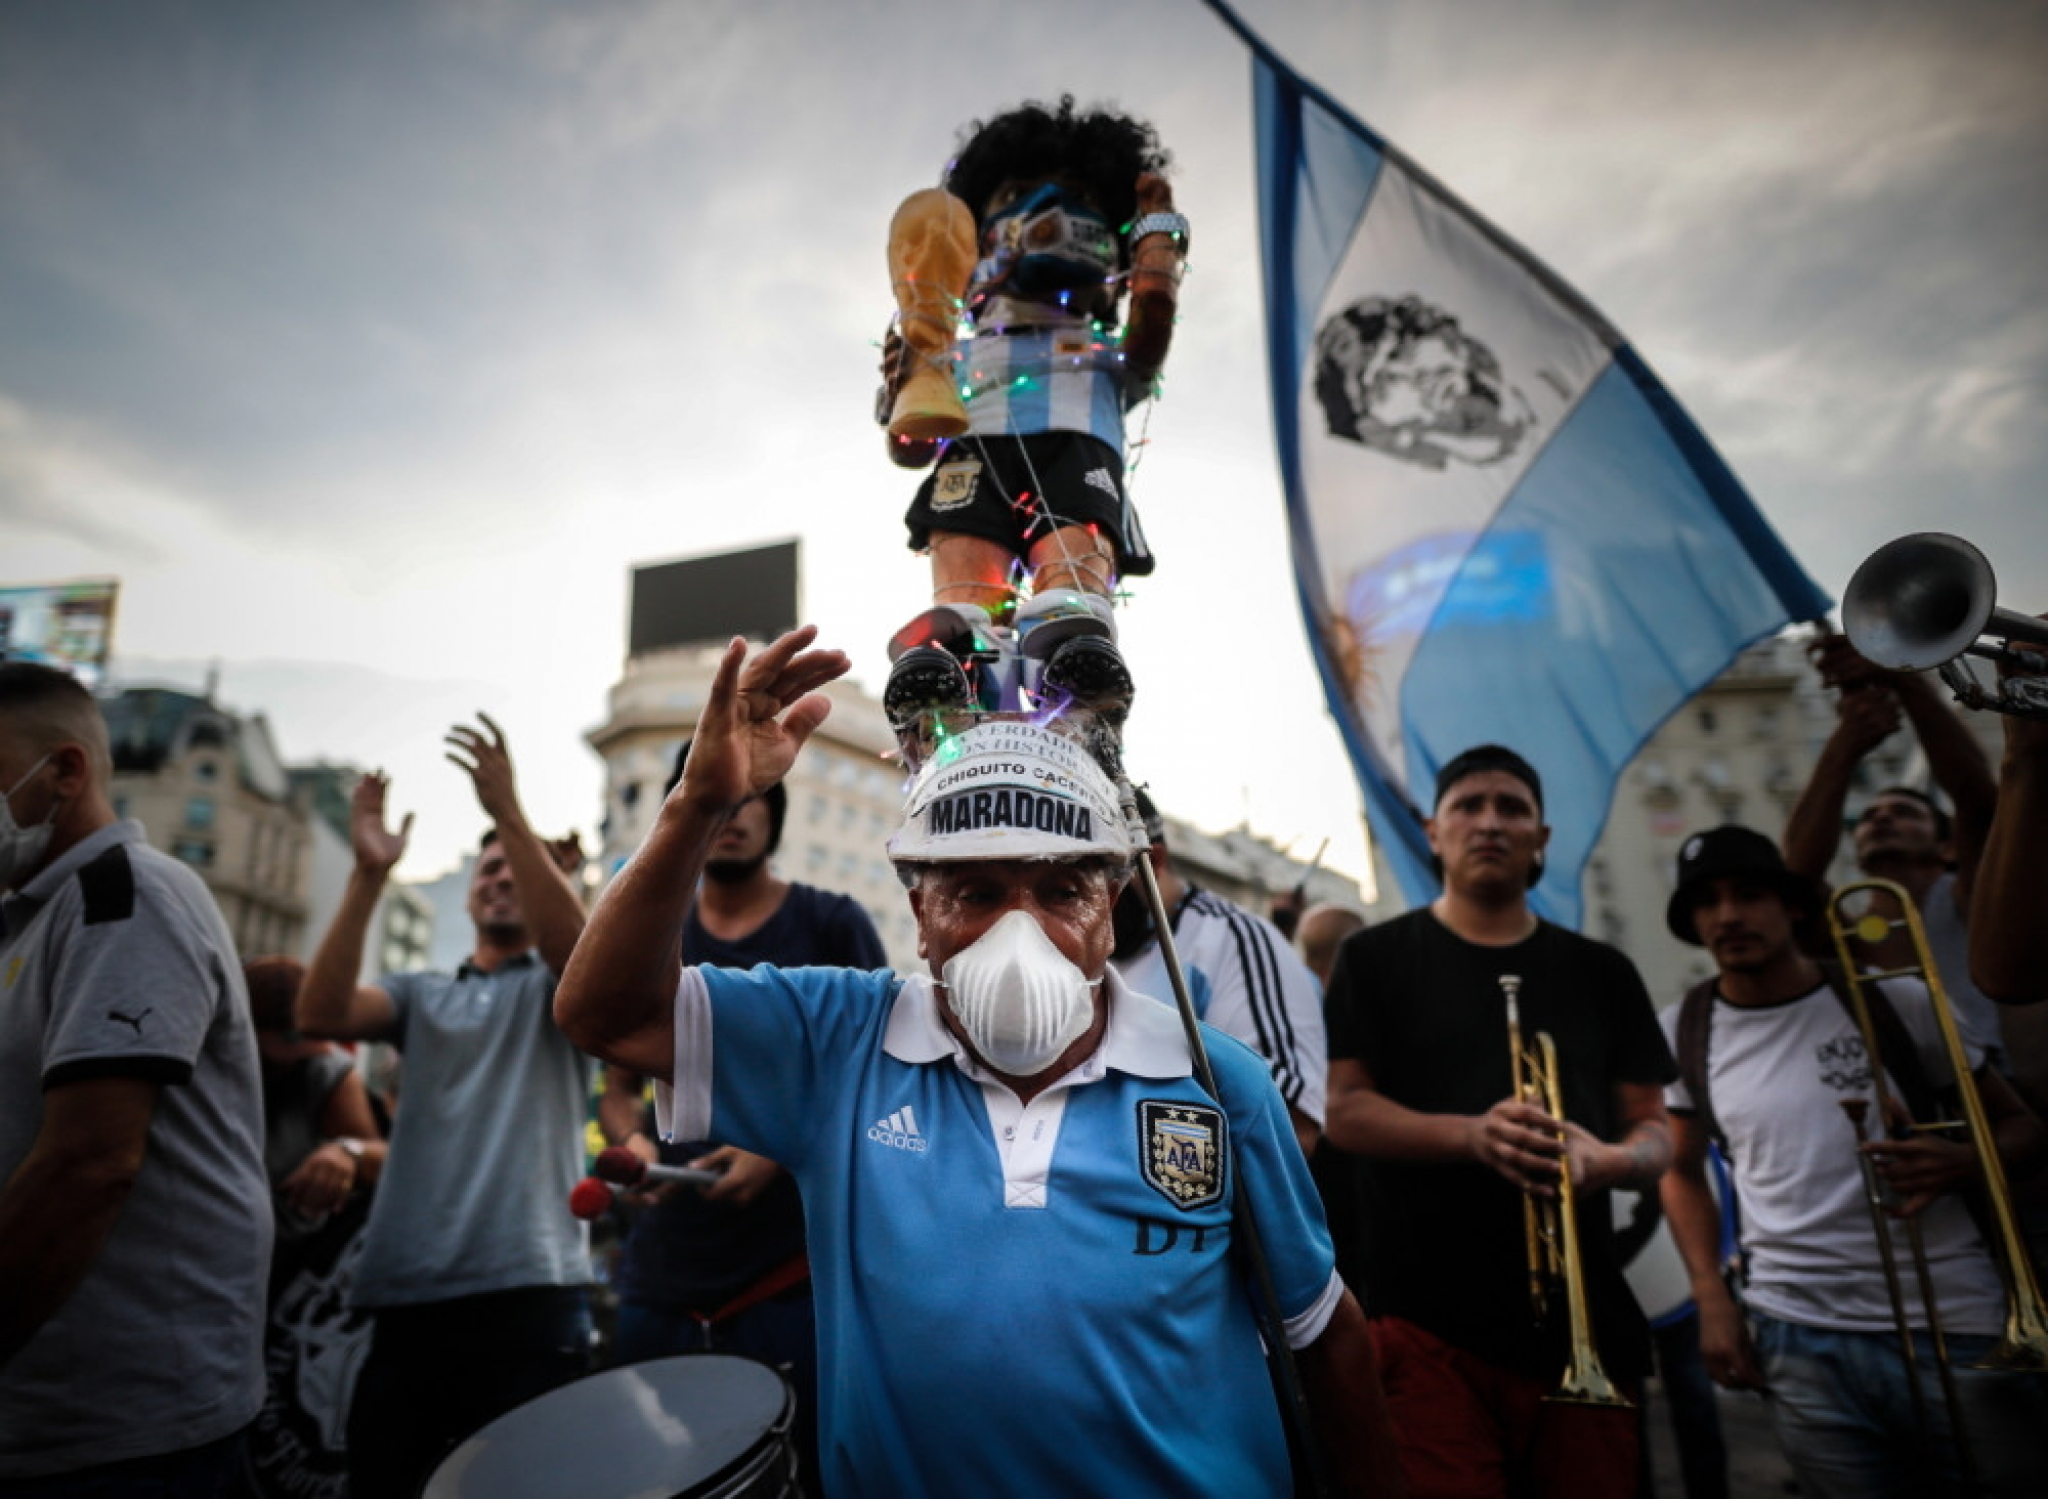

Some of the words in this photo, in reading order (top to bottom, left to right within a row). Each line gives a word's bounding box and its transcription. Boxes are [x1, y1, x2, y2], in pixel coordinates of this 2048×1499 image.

[937, 763, 1026, 791] CHIQUITO
[931, 790, 1092, 841] MARADONA
[867, 1126, 927, 1152] adidas
[1166, 1136, 1202, 1174] AFA
